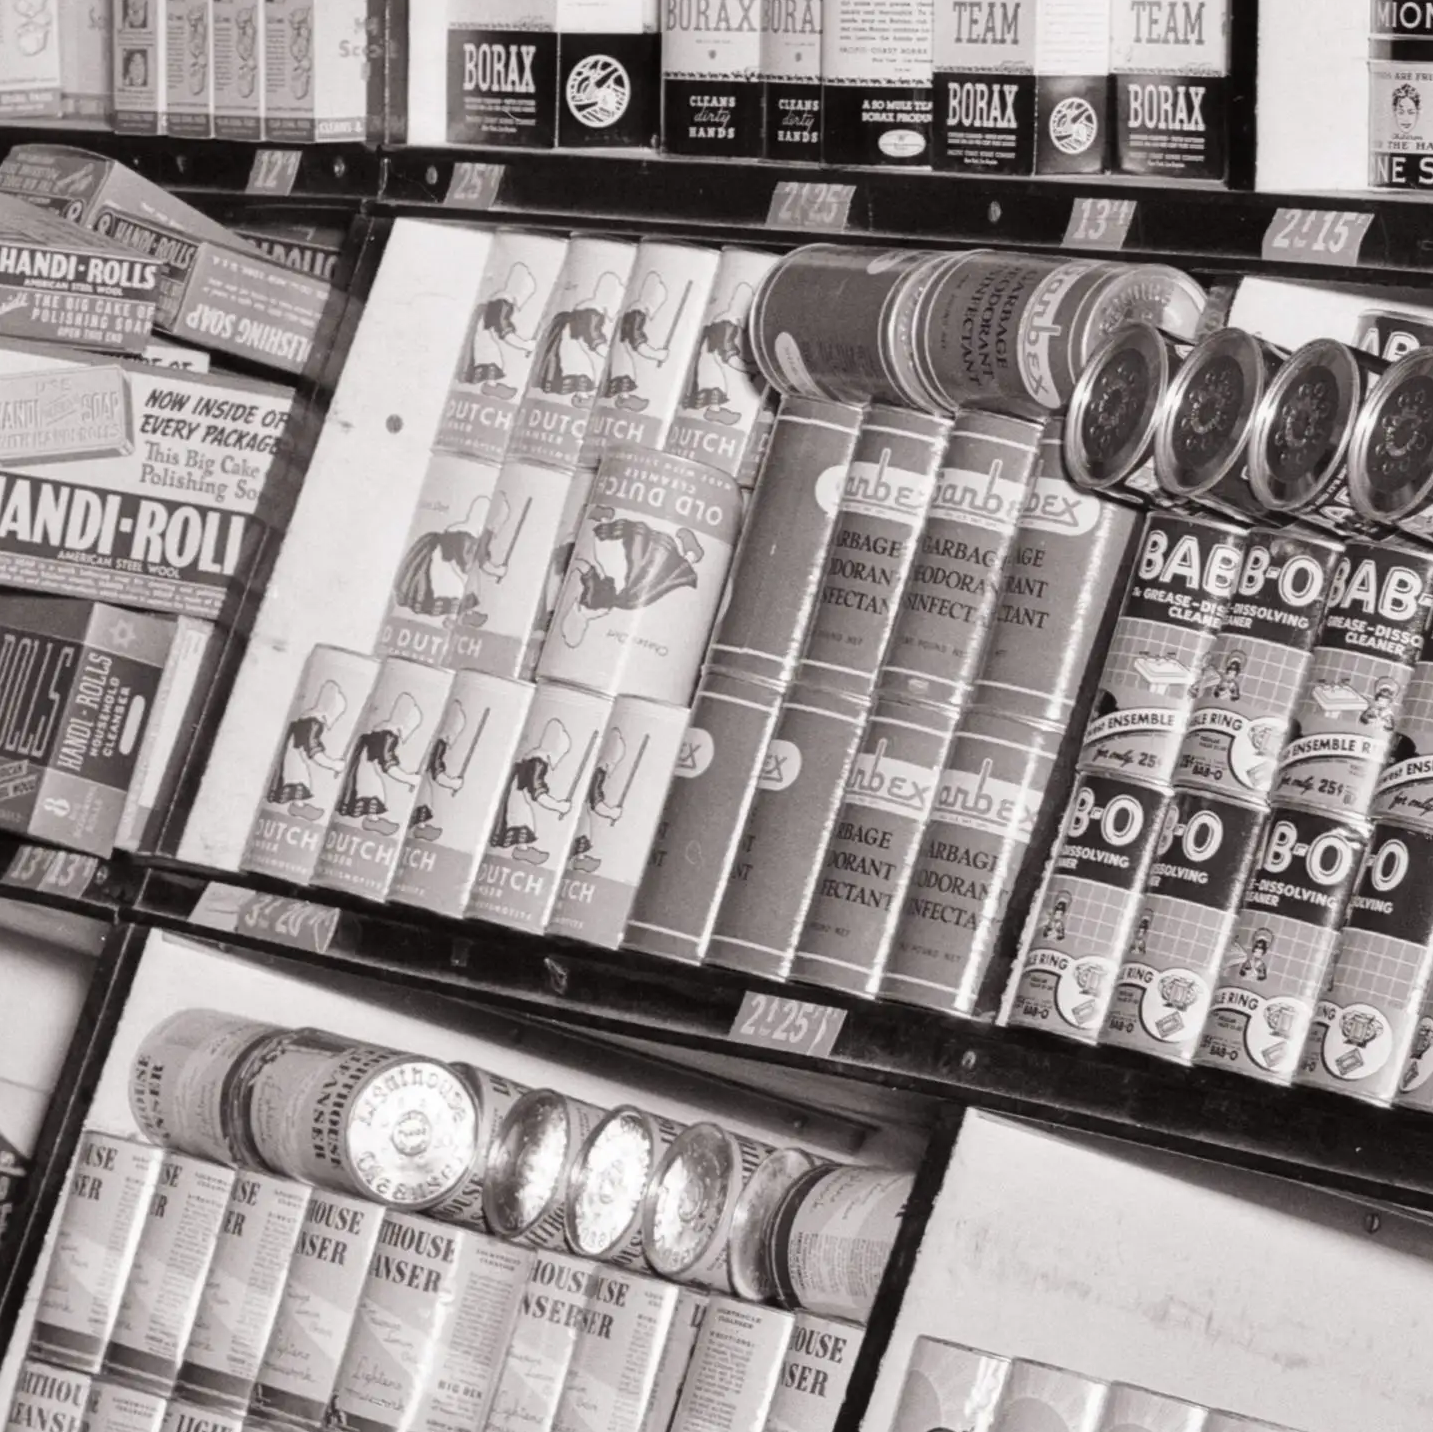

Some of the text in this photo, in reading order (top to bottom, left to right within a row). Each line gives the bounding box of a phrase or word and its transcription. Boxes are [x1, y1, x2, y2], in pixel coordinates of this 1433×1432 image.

[1132, 2, 1205, 44] TEAM
[462, 46, 536, 92] BORAX
[689, 95, 735, 109] CLEANS
[694, 108, 731, 127] dirty
[1128, 85, 1205, 129] BORAX
[689, 126, 735, 140] HANDS
[146, 390, 185, 411] NOW
[191, 396, 256, 423] INSIDE
[140, 415, 196, 440] EVERY
[146, 442, 258, 478] This Big Cake
[140, 467, 229, 501] Polishing
[58, 550, 180, 579] AMERICAN STEEL WOOL
[89, 677, 119, 756] HOUSEHOLD
[102, 687, 129, 756] CLEANSER
